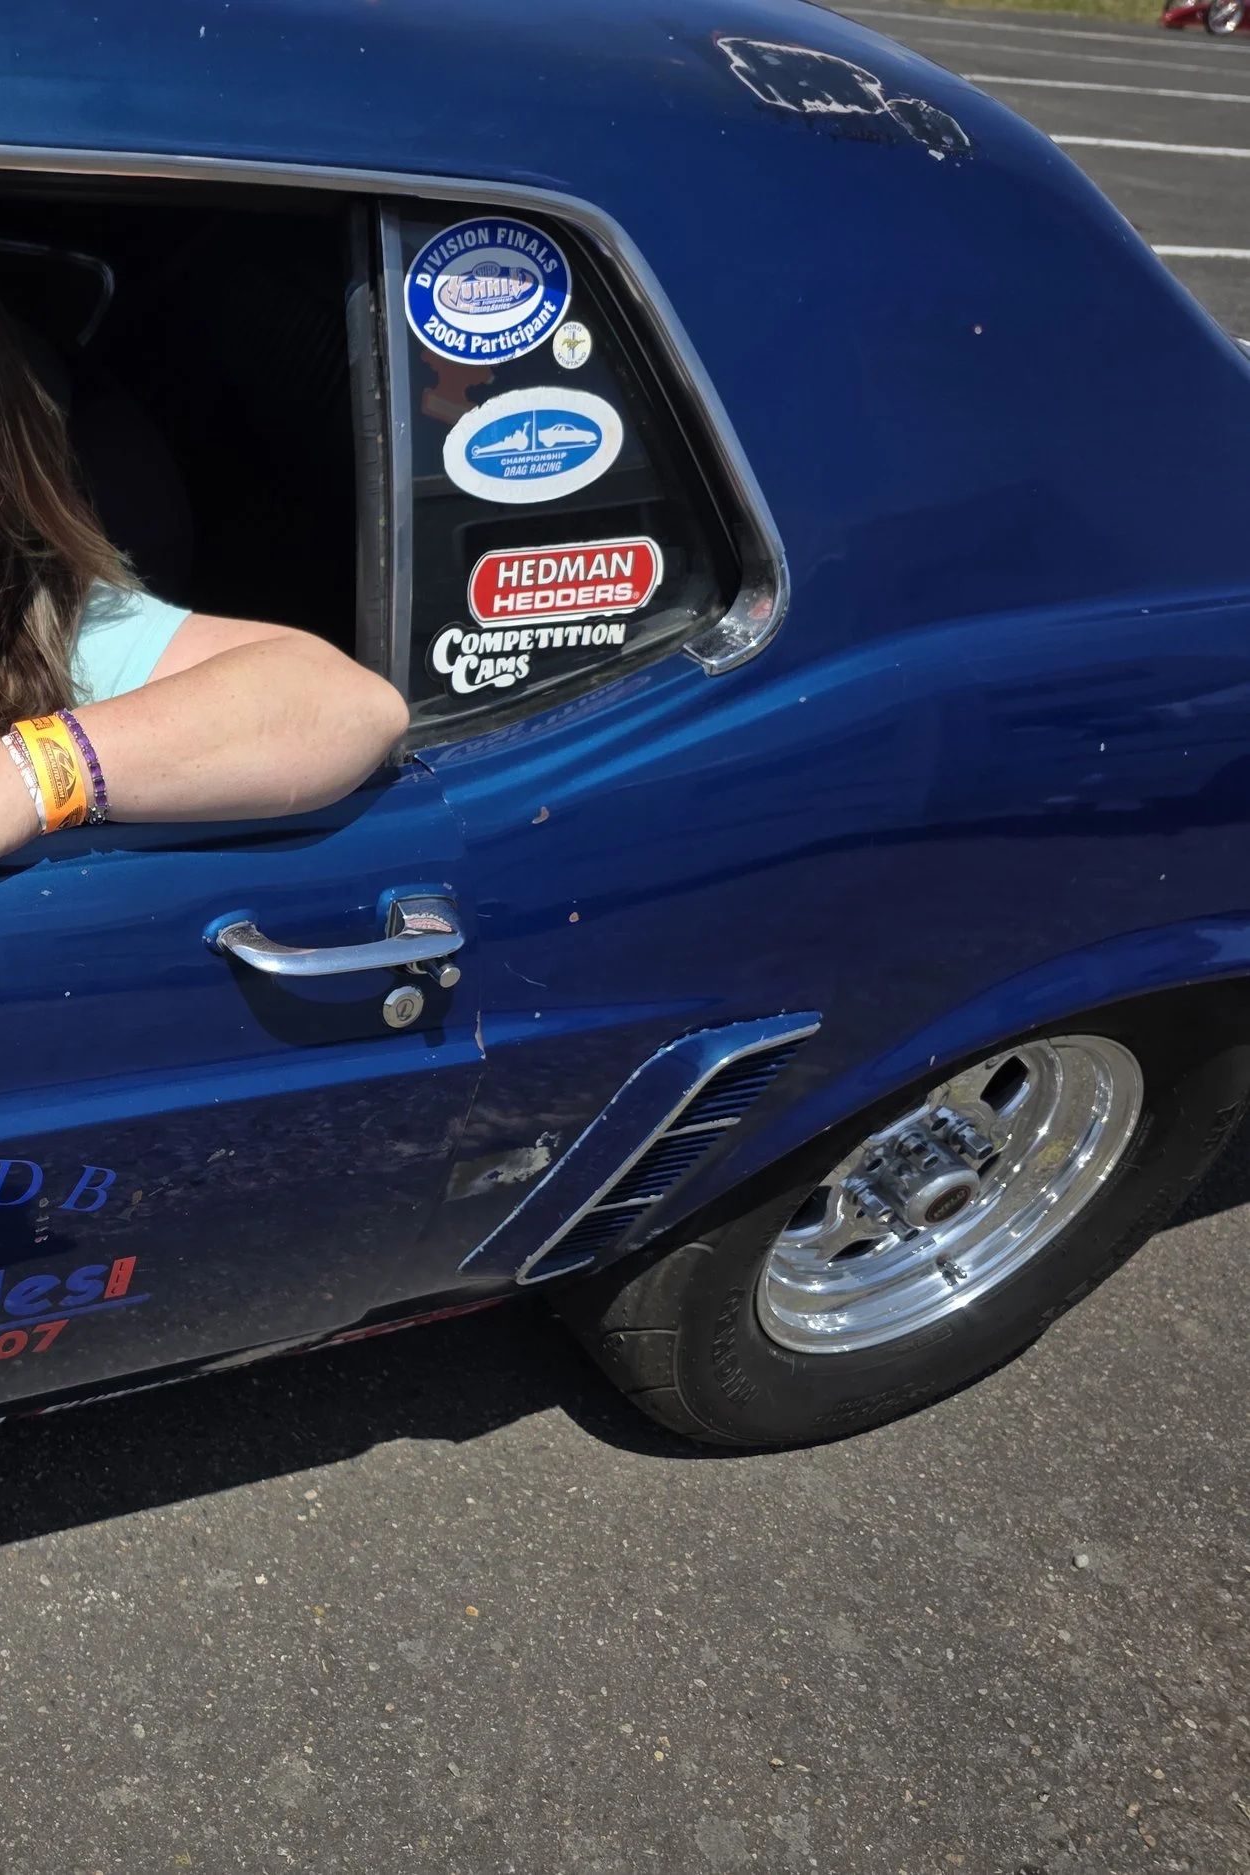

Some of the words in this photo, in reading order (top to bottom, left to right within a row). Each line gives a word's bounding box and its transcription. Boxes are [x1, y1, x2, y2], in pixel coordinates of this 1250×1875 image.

[415, 227, 490, 289] DIVISION
[496, 226, 559, 274] FINALS
[422, 314, 468, 352] 2004
[469, 299, 558, 354] Participant
[500, 452, 567, 466] CHAMPIONSHIP
[503, 464, 526, 478] DRAG
[529, 461, 563, 475] RACING
[497, 550, 635, 589] HEDMAN
[492, 582, 634, 614] HEDDERS
